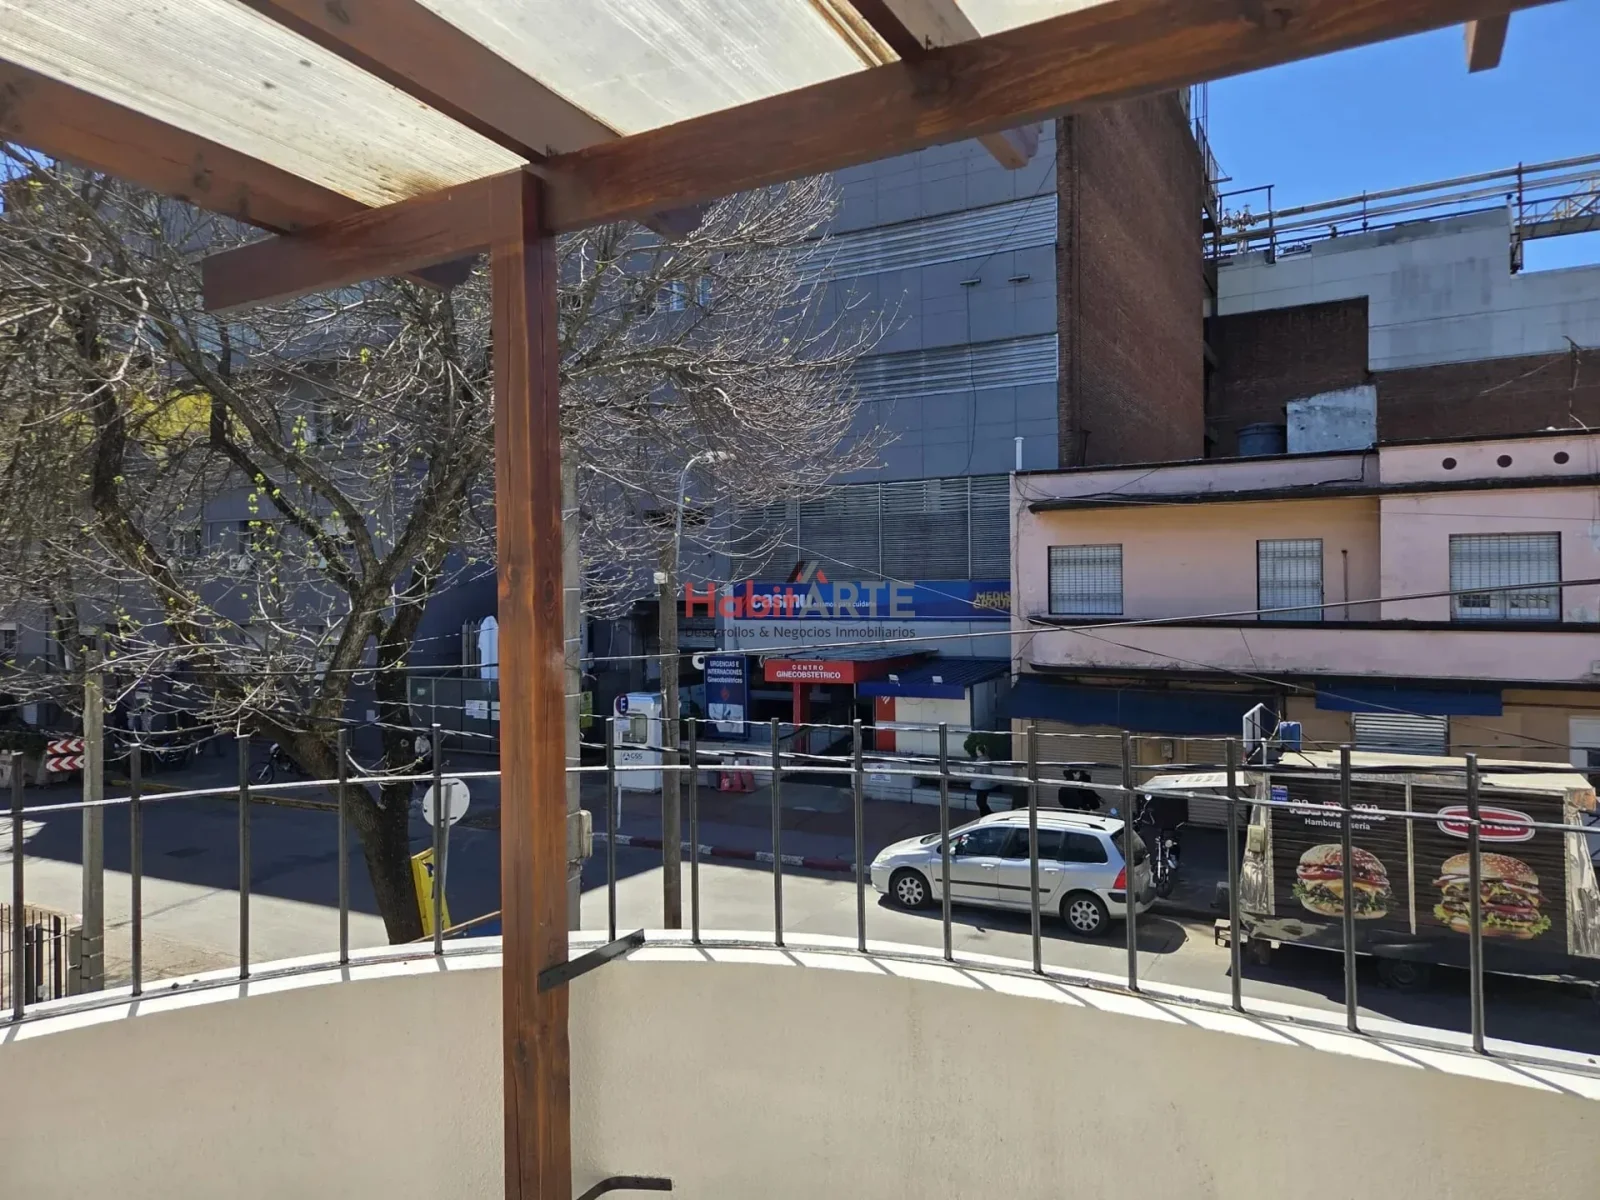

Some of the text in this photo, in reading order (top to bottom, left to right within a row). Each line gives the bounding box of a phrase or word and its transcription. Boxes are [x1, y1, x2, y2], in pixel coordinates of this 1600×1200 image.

[751, 593, 814, 609] casmu
[620, 698, 626, 712] E
[1304, 817, 1371, 831] Hamburgseria
